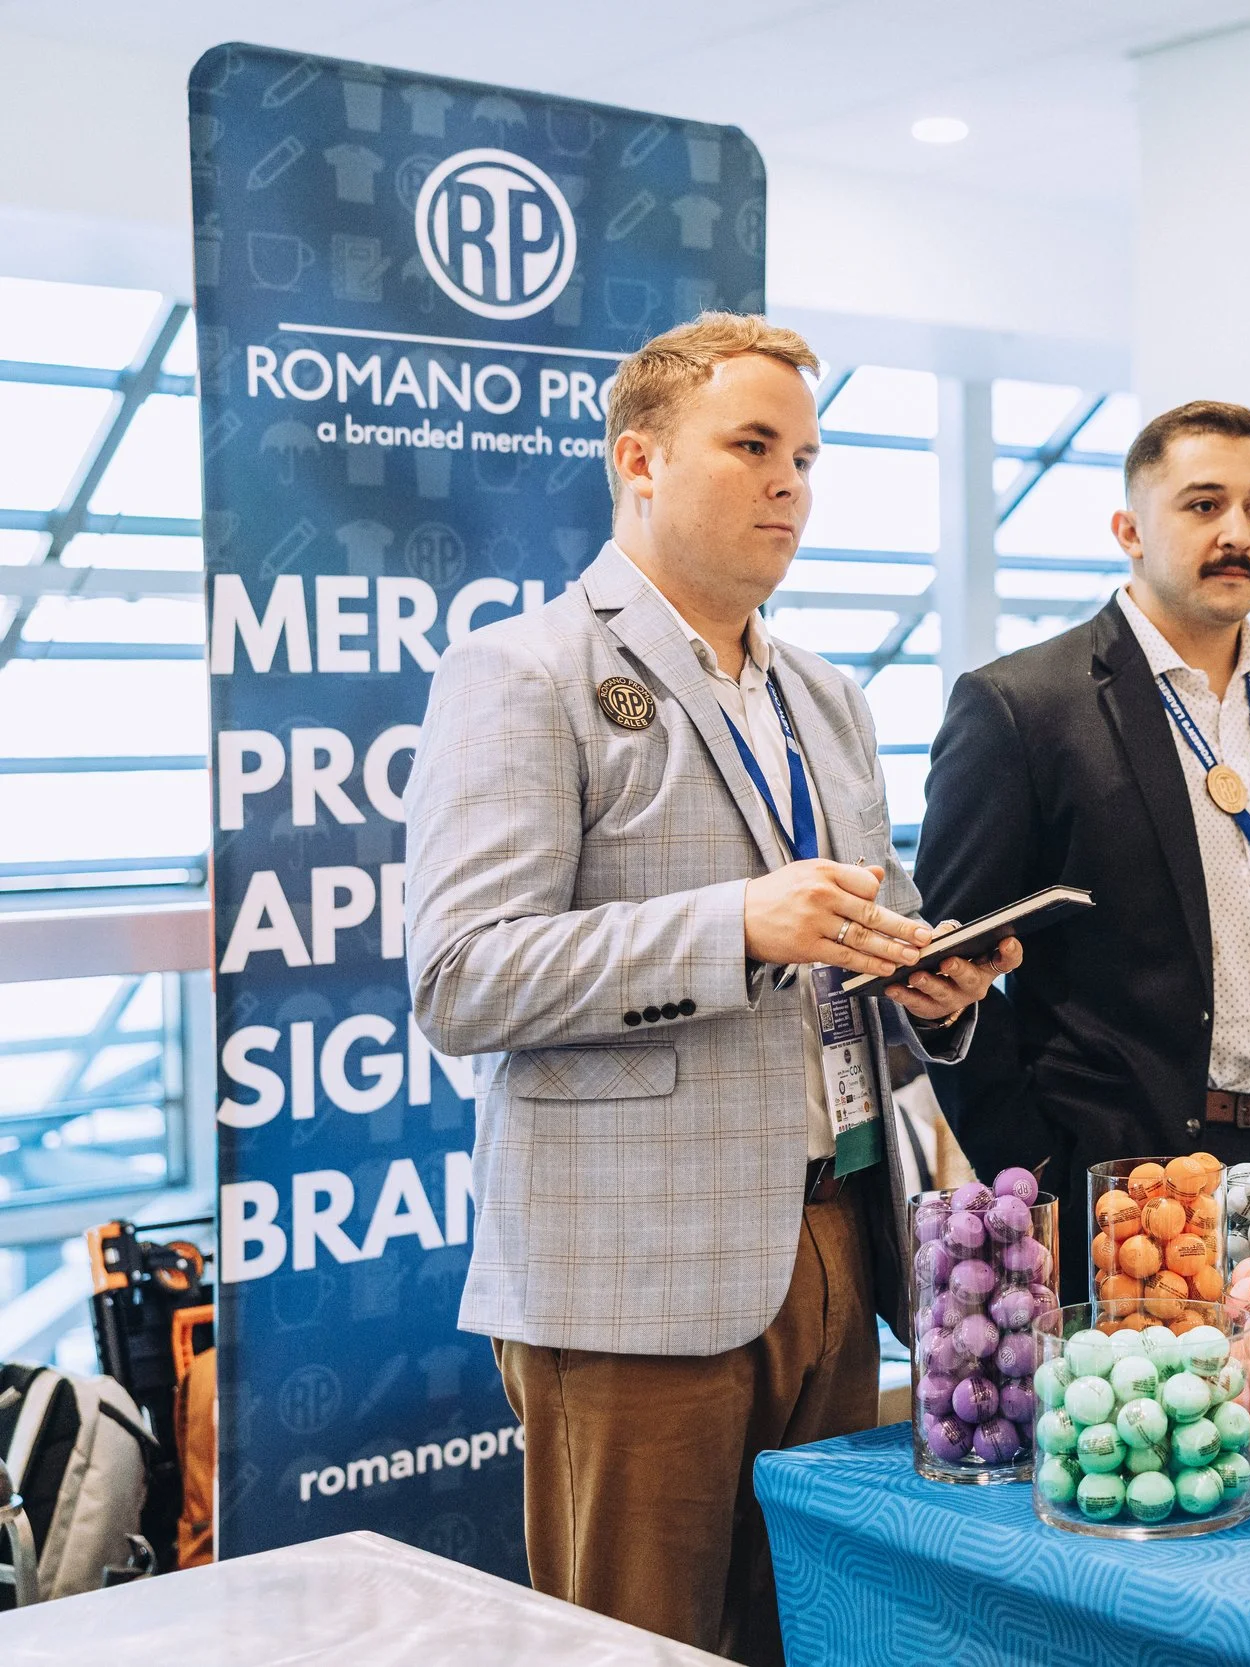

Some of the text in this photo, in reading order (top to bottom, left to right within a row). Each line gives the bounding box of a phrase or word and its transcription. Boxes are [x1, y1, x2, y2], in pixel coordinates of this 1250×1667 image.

[246, 345, 614, 421] ROMANO PR
[317, 421, 337, 443] a
[346, 414, 463, 451] branded
[471, 426, 552, 455] merch
[210, 573, 588, 675] MERC
[600, 677, 654, 705] ROMANO PROMO
[617, 715, 648, 727] CALEB
[849, 1064, 863, 1076] COX
